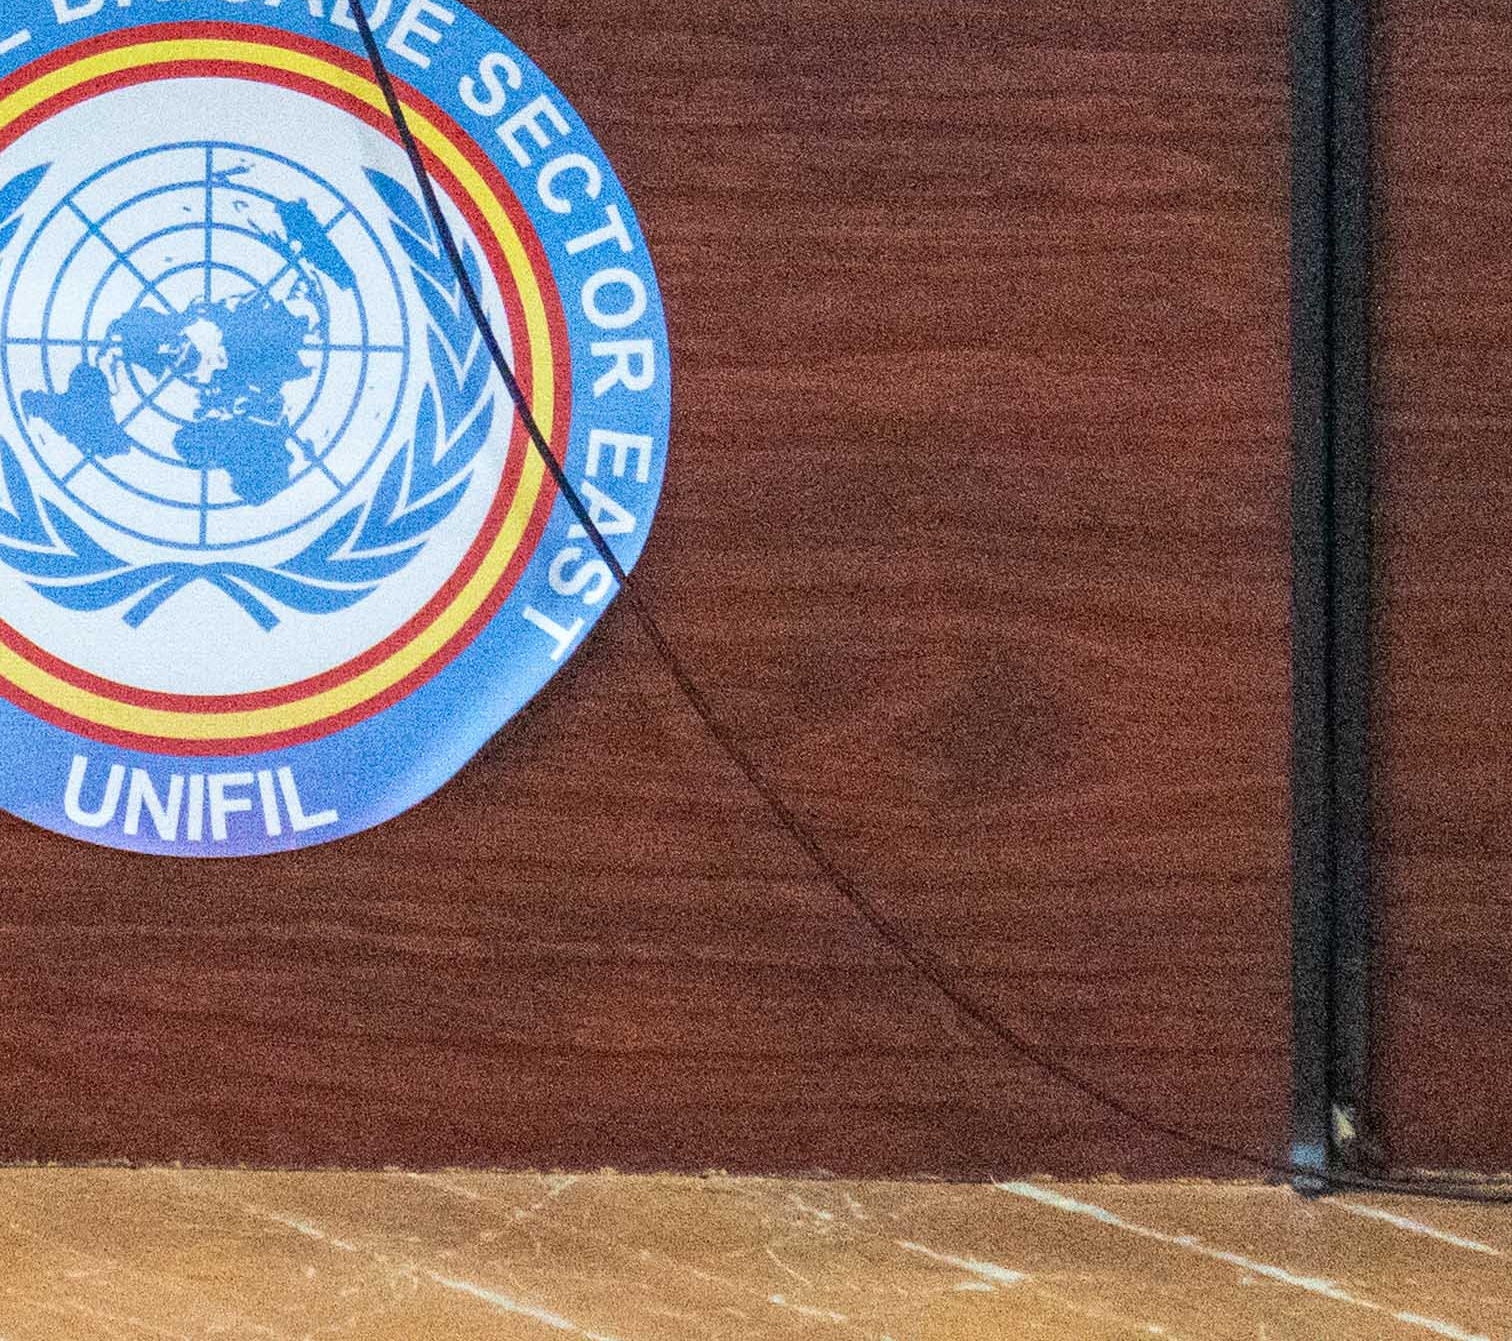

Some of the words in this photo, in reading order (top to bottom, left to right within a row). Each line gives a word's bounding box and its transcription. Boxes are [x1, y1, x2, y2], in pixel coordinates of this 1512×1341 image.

[459, 51, 655, 401] SECTOR
[521, 429, 652, 661] EAST
[61, 754, 339, 843] UNIFIL
